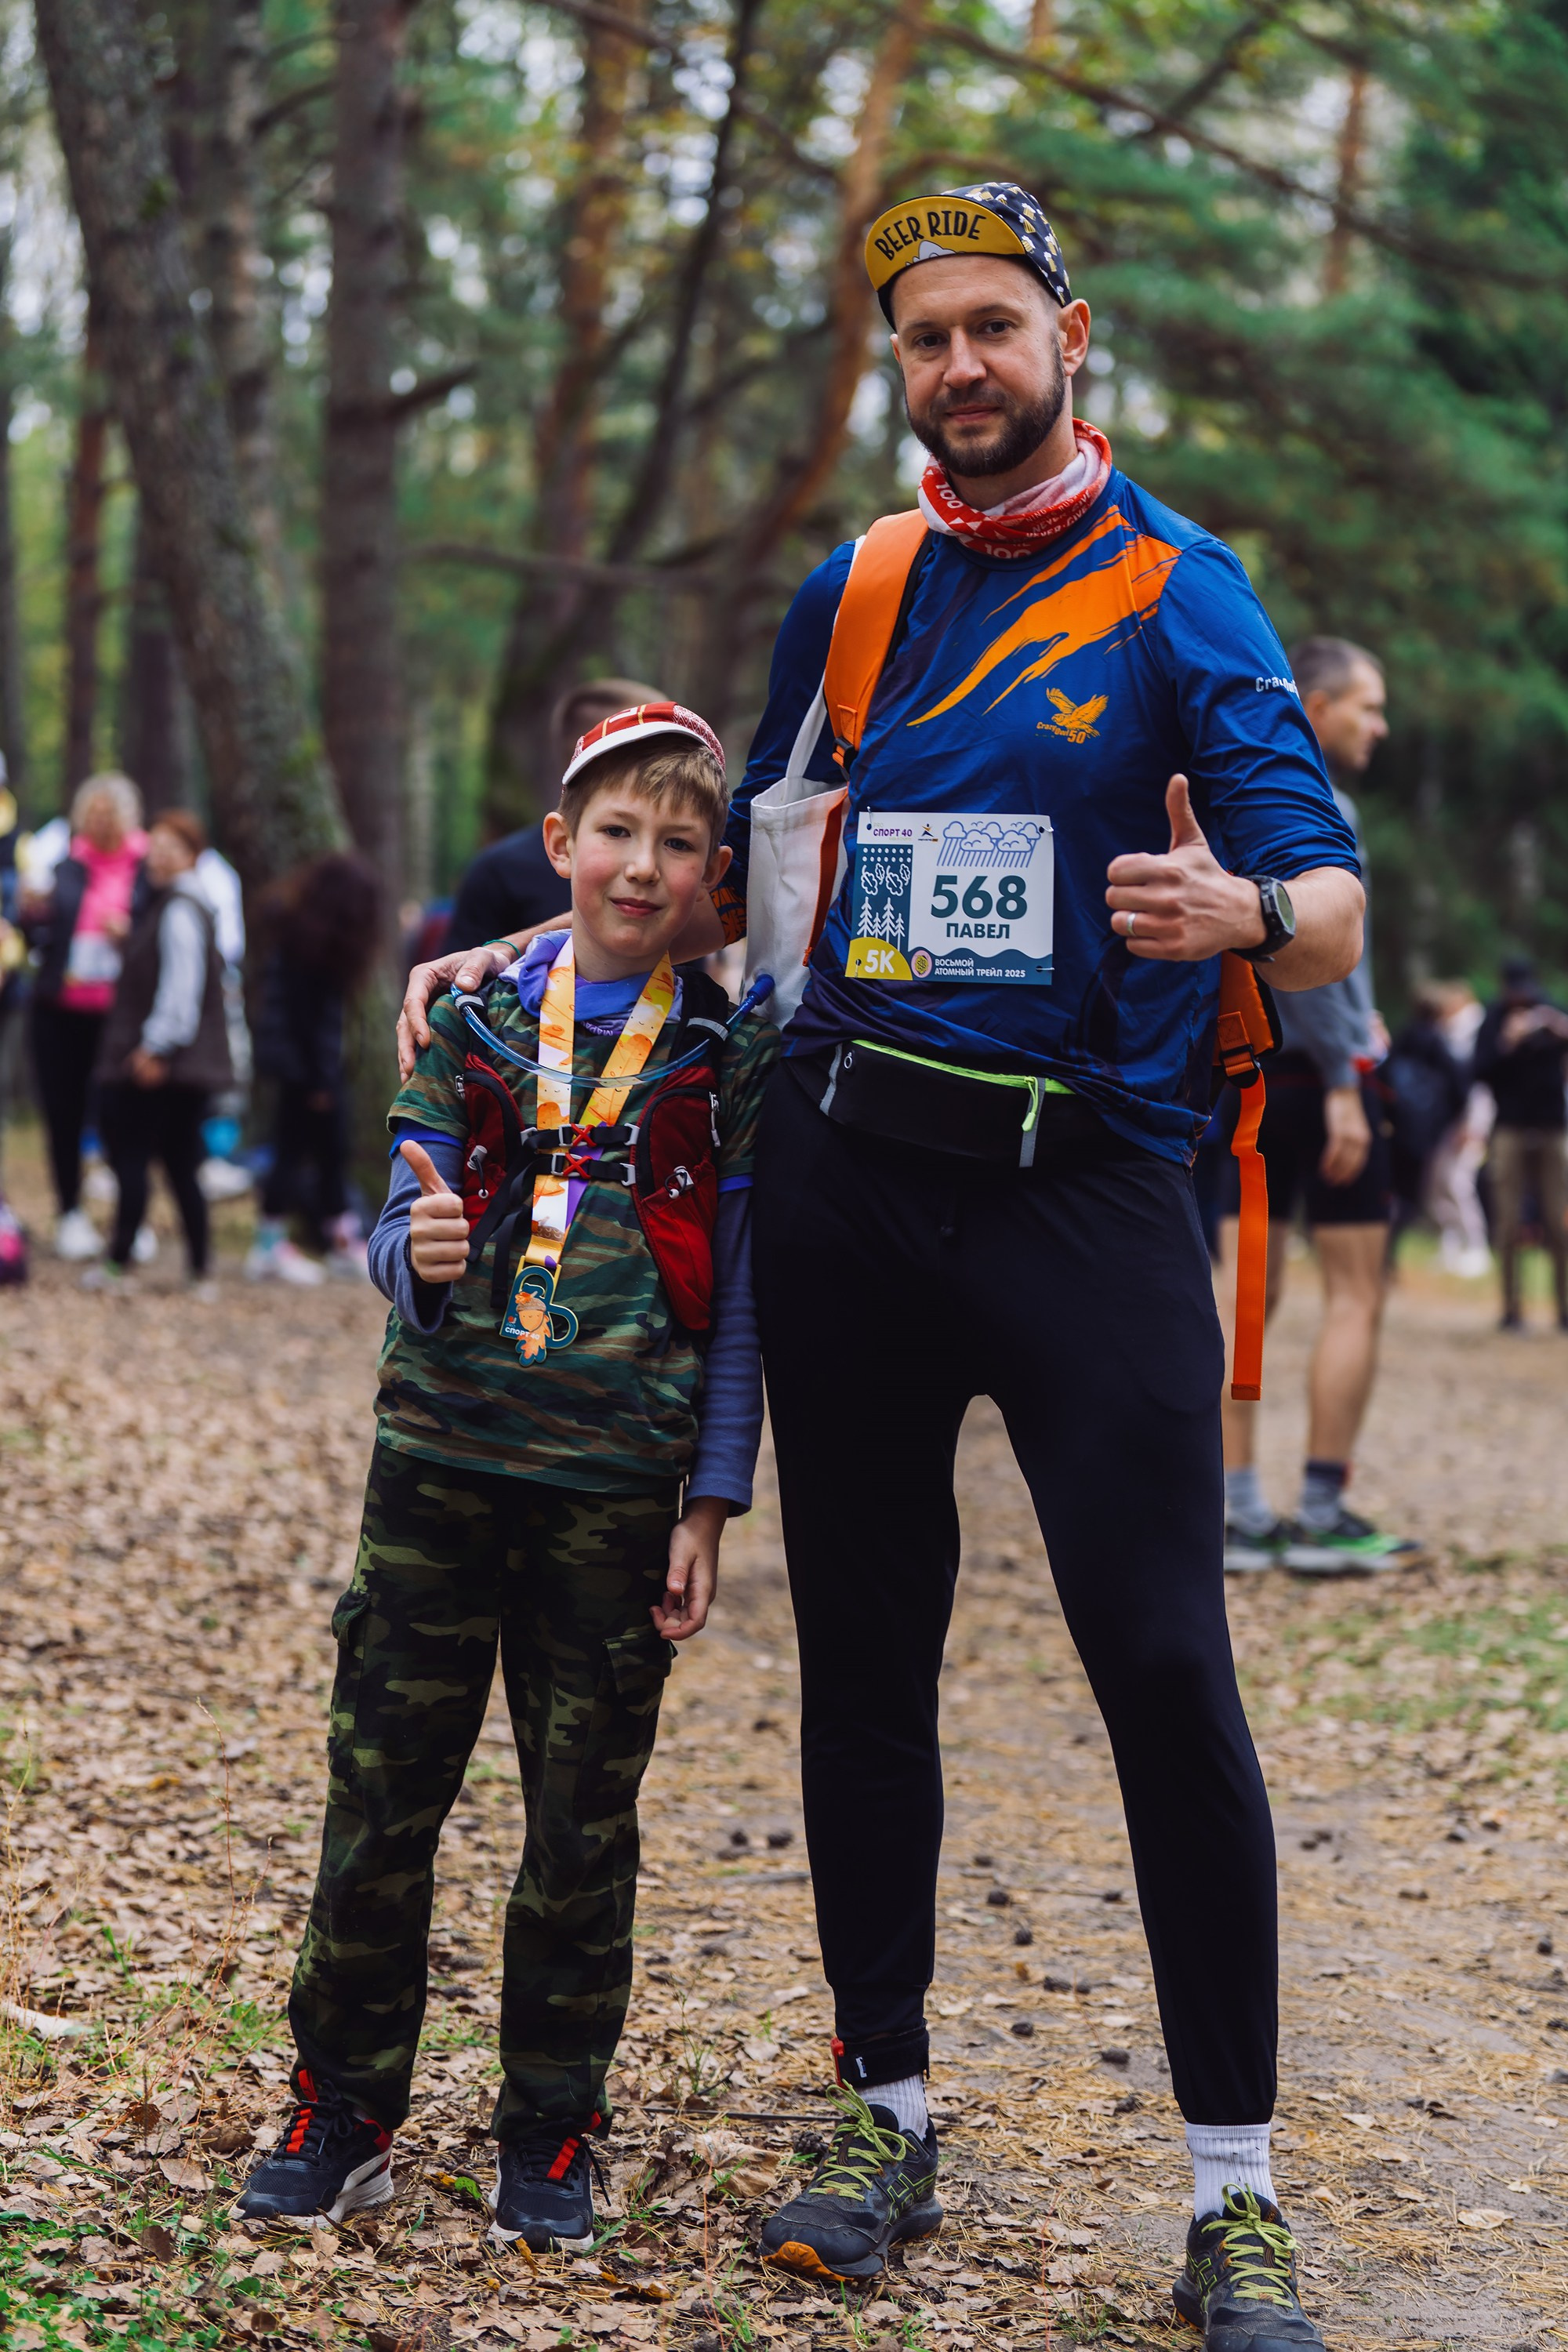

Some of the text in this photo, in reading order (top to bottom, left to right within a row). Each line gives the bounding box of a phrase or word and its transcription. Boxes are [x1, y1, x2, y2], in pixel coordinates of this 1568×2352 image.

[874, 210, 986, 261] BEER RIDE
[931, 875, 1027, 920] 568
[946, 923, 1010, 938] ПАВЕЛ
[864, 949, 895, 974] 5K
[935, 958, 974, 967] ВОСЬМОЙ
[935, 967, 1025, 978] АТОМНЫЙ ТРЕЙЛ 2025
